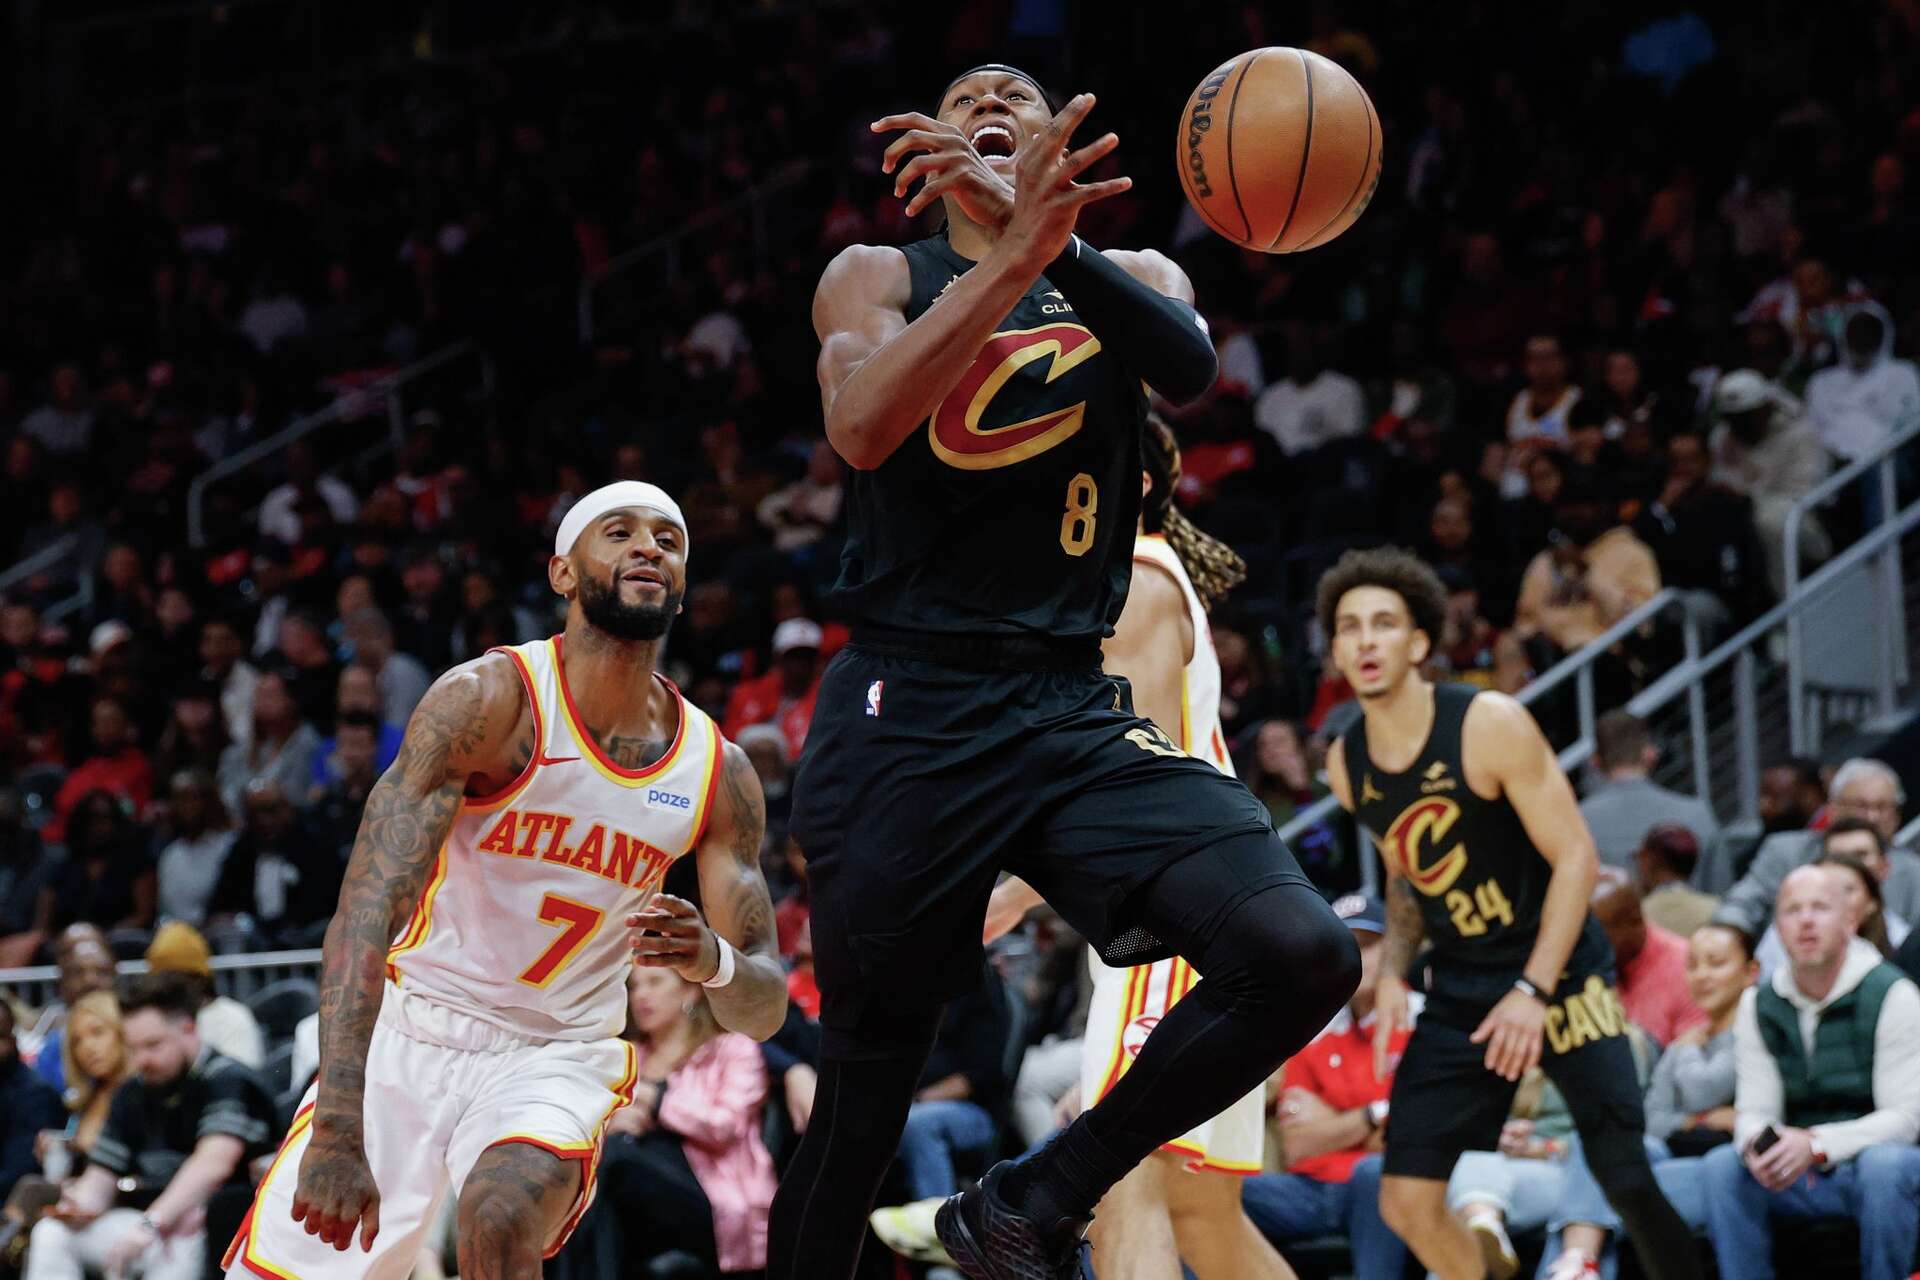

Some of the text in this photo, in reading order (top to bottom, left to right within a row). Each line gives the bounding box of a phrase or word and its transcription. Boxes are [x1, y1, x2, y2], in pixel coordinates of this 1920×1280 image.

[1188, 64, 1236, 197] Wilson
[1041, 303, 1073, 314] CLI
[928, 322, 1101, 470] C
[1060, 472, 1098, 557] 8
[647, 789, 691, 809] paze
[479, 811, 675, 890] ATLANT
[1385, 796, 1468, 896] C
[517, 892, 606, 989] 7
[1445, 878, 1514, 937] 24
[1545, 974, 1626, 1054] CAV
